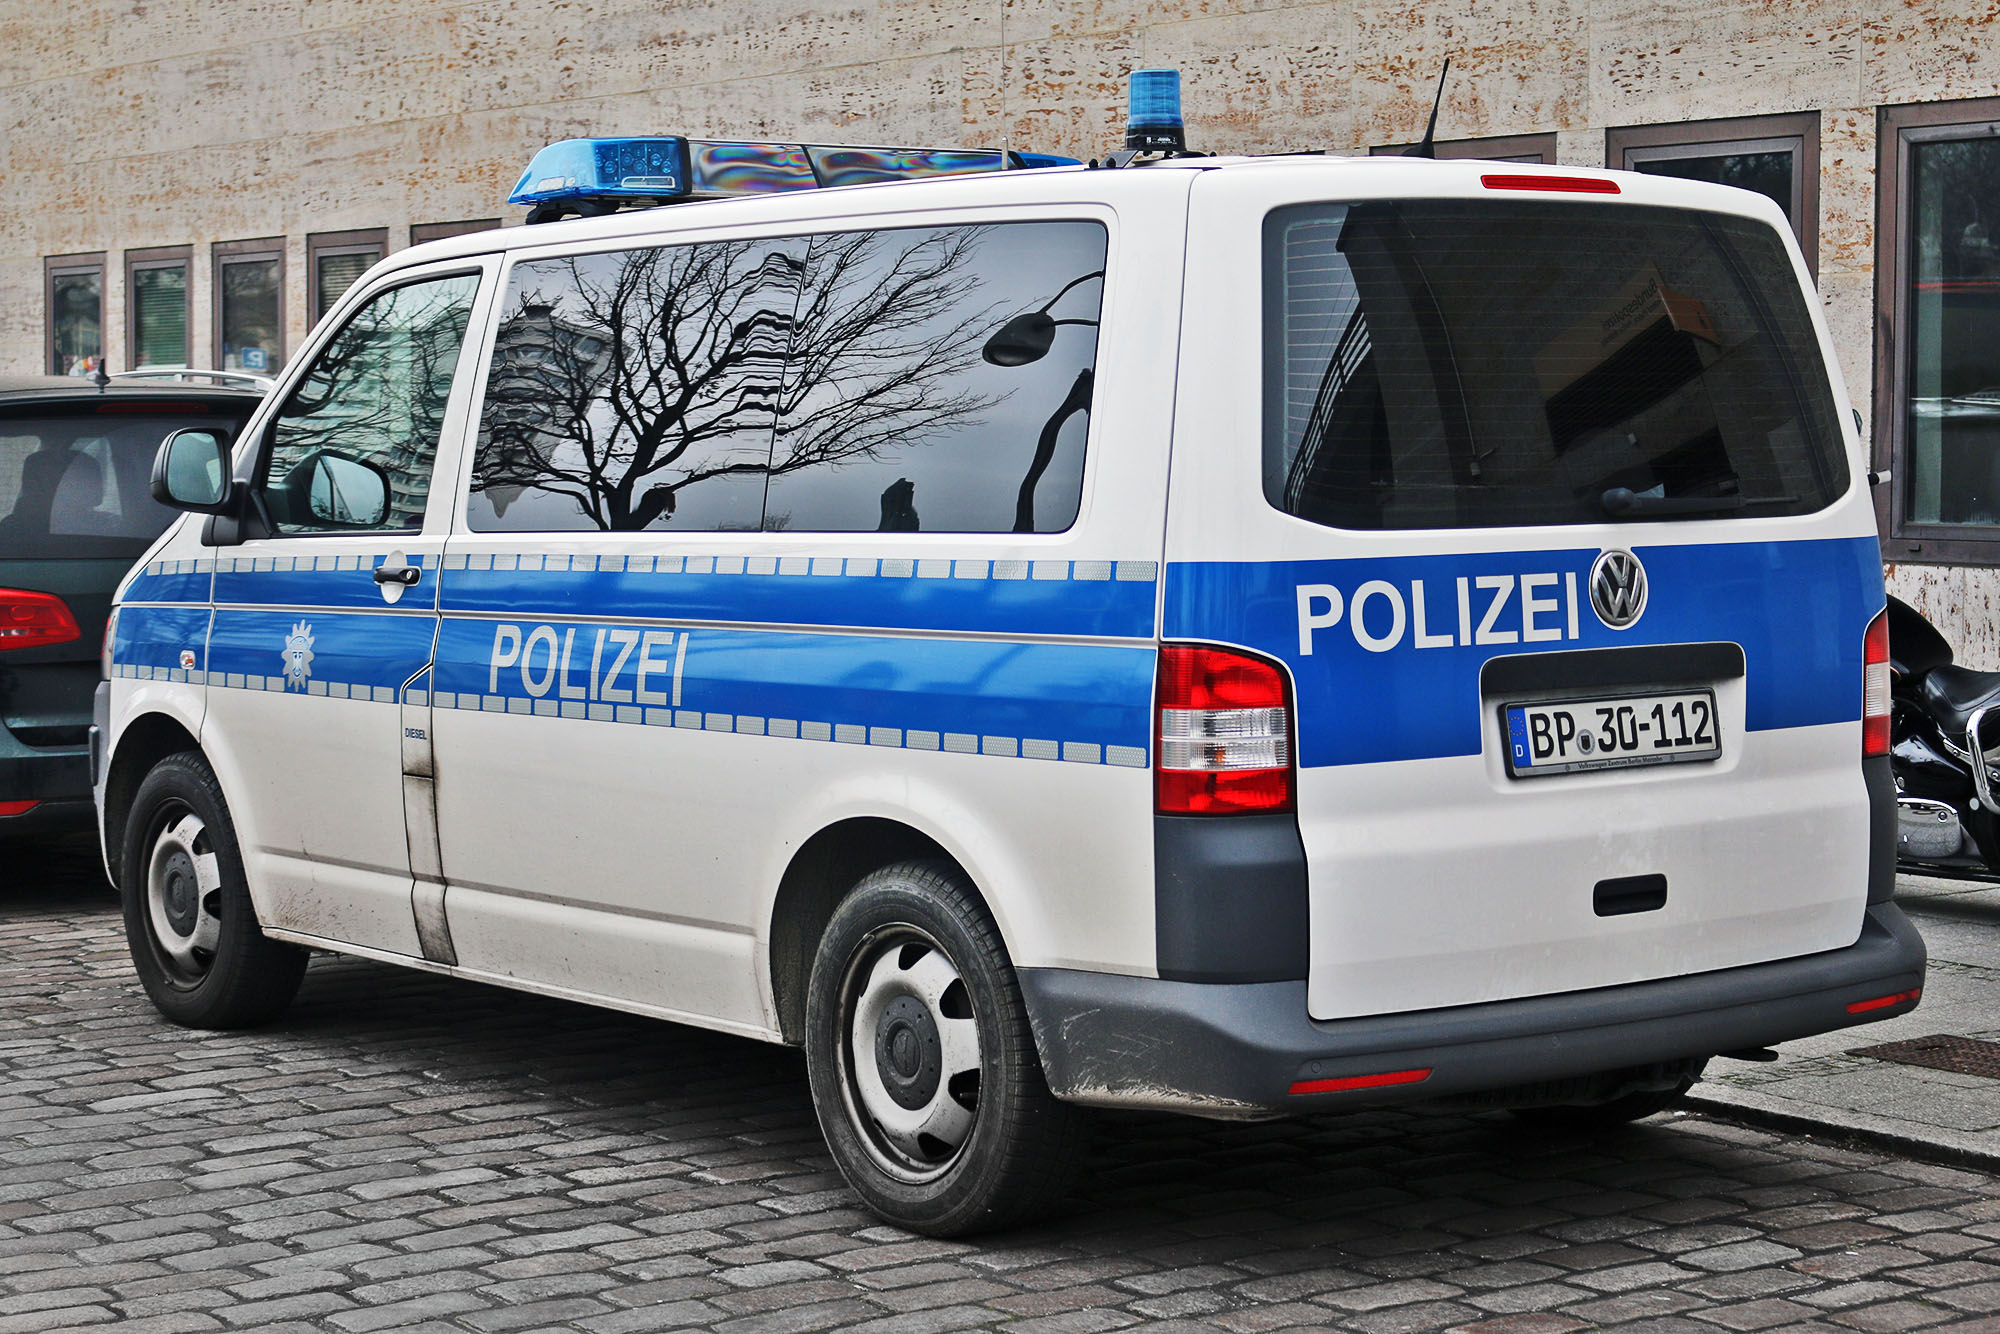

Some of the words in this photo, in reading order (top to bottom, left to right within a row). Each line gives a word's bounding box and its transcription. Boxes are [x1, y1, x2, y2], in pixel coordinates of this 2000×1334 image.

[1296, 571, 1580, 656] POLIZEI
[489, 623, 690, 707] POLIZEI
[405, 727, 427, 740] DIESEL
[1529, 711, 1576, 759] BP
[1595, 700, 1713, 752] 30-112
[1515, 744, 1524, 757] D
[1578, 761, 1607, 769] Volkswagen
